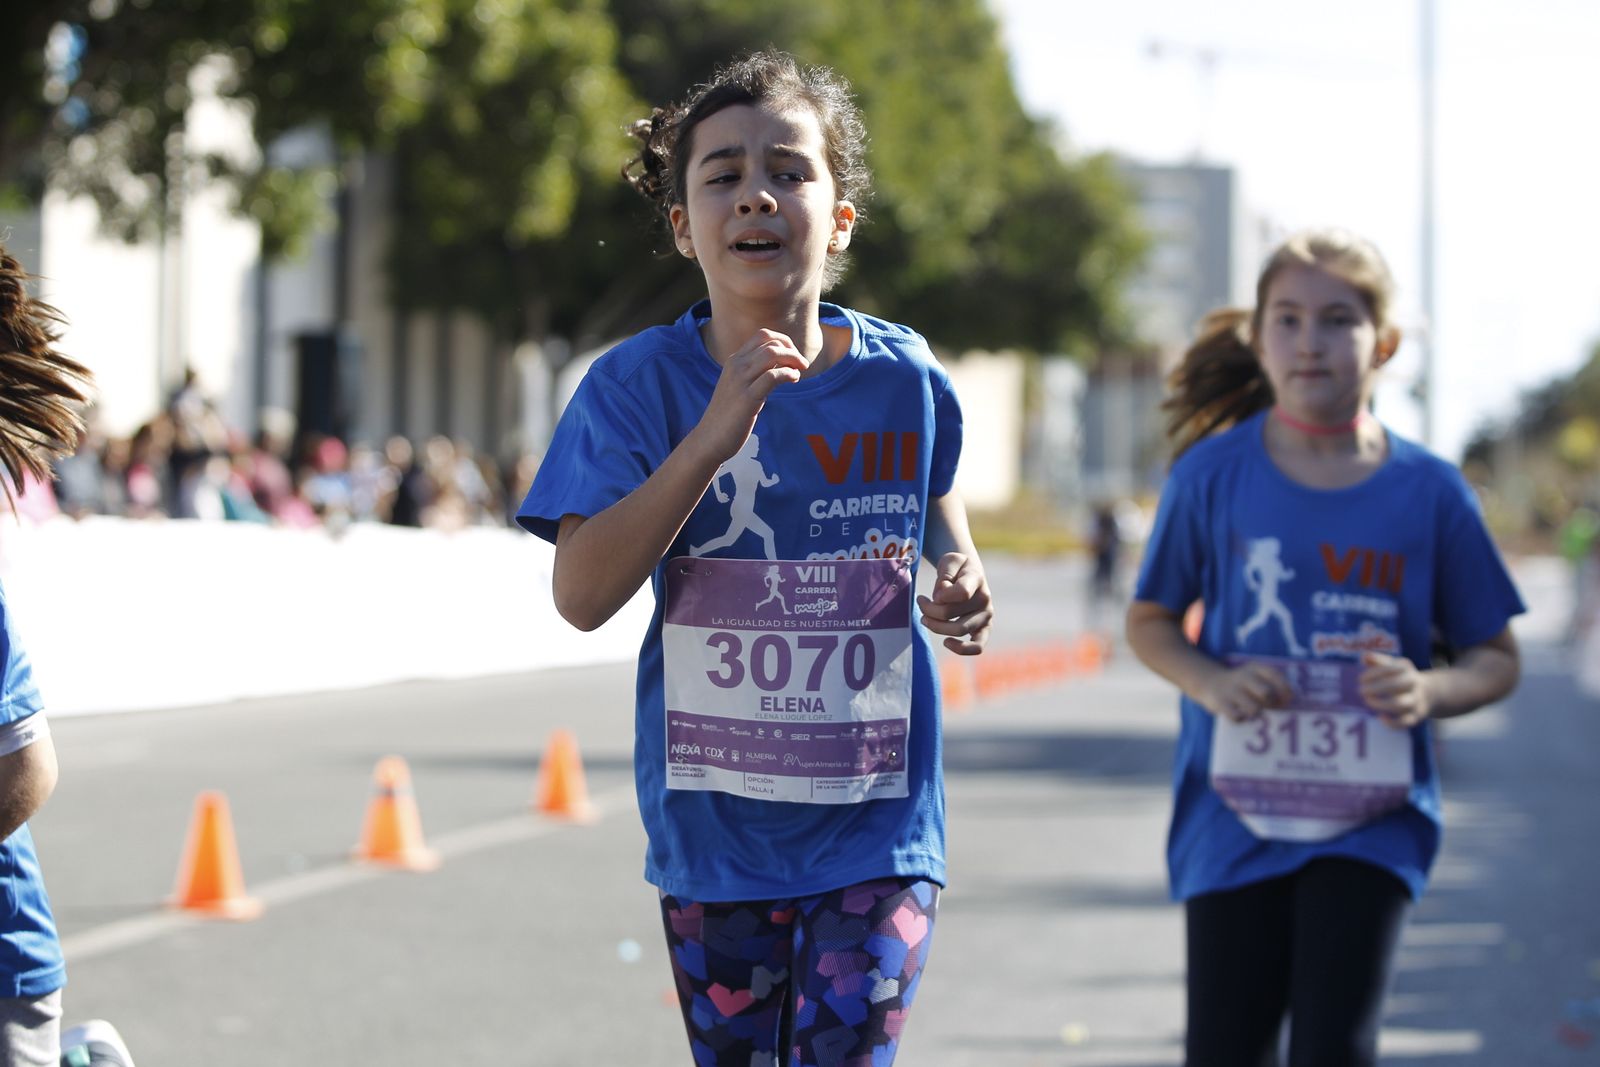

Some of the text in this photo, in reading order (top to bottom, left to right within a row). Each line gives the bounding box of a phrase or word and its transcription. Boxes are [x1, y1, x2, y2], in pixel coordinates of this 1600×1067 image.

[807, 431, 918, 484] VIII
[809, 494, 920, 519] CARRERA
[795, 566, 836, 583] VIII
[1319, 543, 1406, 593] VIII
[794, 598, 839, 617] mujer
[727, 618, 781, 628] IGUALDAD
[784, 620, 797, 628] ES
[801, 620, 846, 629] NUESTRA
[847, 619, 872, 627] META
[706, 632, 875, 692] 3070
[760, 696, 826, 713] ELENA
[1246, 713, 1369, 760] 3131
[671, 743, 701, 756] NEXA
[704, 746, 727, 759] CDX
